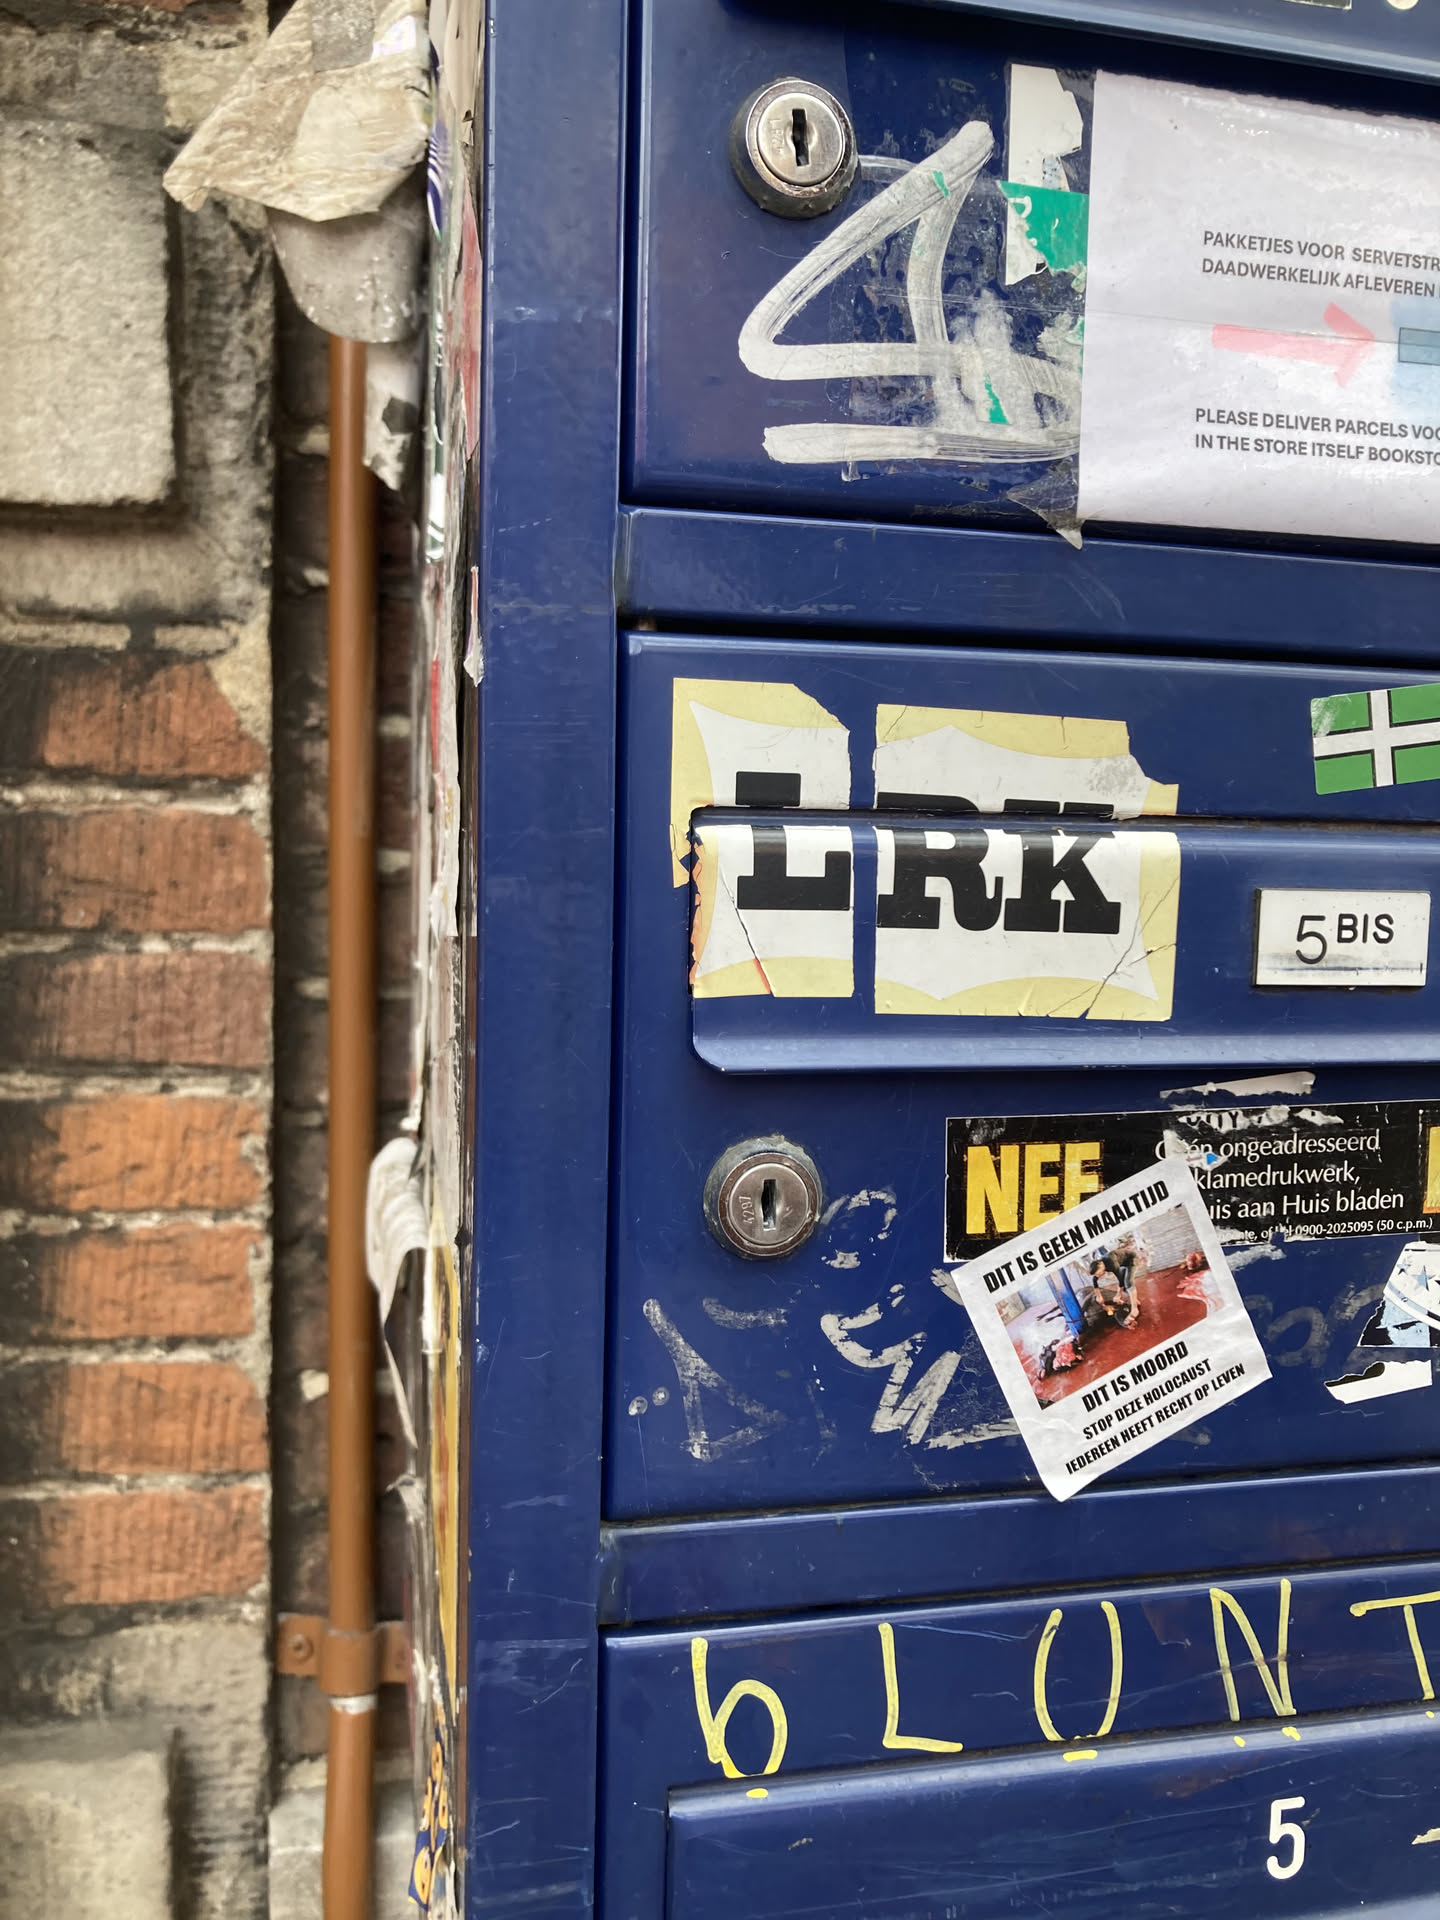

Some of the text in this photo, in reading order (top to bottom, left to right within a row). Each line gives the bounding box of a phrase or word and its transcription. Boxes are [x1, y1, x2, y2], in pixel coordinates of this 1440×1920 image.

[1203, 230, 1440, 271] PAKKETJES VOOR SERVETSTR
[1202, 258, 1341, 287] DAADWERKELIJK
[1343, 274, 1436, 297] AFLEVEREN
[1195, 408, 1258, 427] PLEASE
[1262, 412, 1332, 433] DELIVER
[1335, 418, 1408, 438] PARCELS
[1195, 434, 1213, 449] IN
[1216, 435, 1250, 451] THE
[1254, 438, 1308, 455] STORE
[1312, 442, 1364, 460] ITSELF
[1296, 913, 1394, 964] 5 BIS
[1219, 1128, 1380, 1163] ongeadresseerd
[1238, 1201, 1275, 1218] aan
[1283, 1193, 1330, 1215] Huis
[1336, 1188, 1404, 1211] bladen
[983, 1180, 1170, 1293] DIT IS GEEN MAALTIJD
[1376, 1219, 1394, 1232] (50
[1396, 1217, 1433, 1232] c.p.m.)
[1082, 1340, 1189, 1412] DIT IS MOORD
[1065, 1363, 1246, 1475] IEDEREEN HEEFT RECHT OP LEVEN
[1083, 1358, 1212, 1440] STOP DEZE HOLOCAUST
[1266, 1796, 1306, 1879] 5
